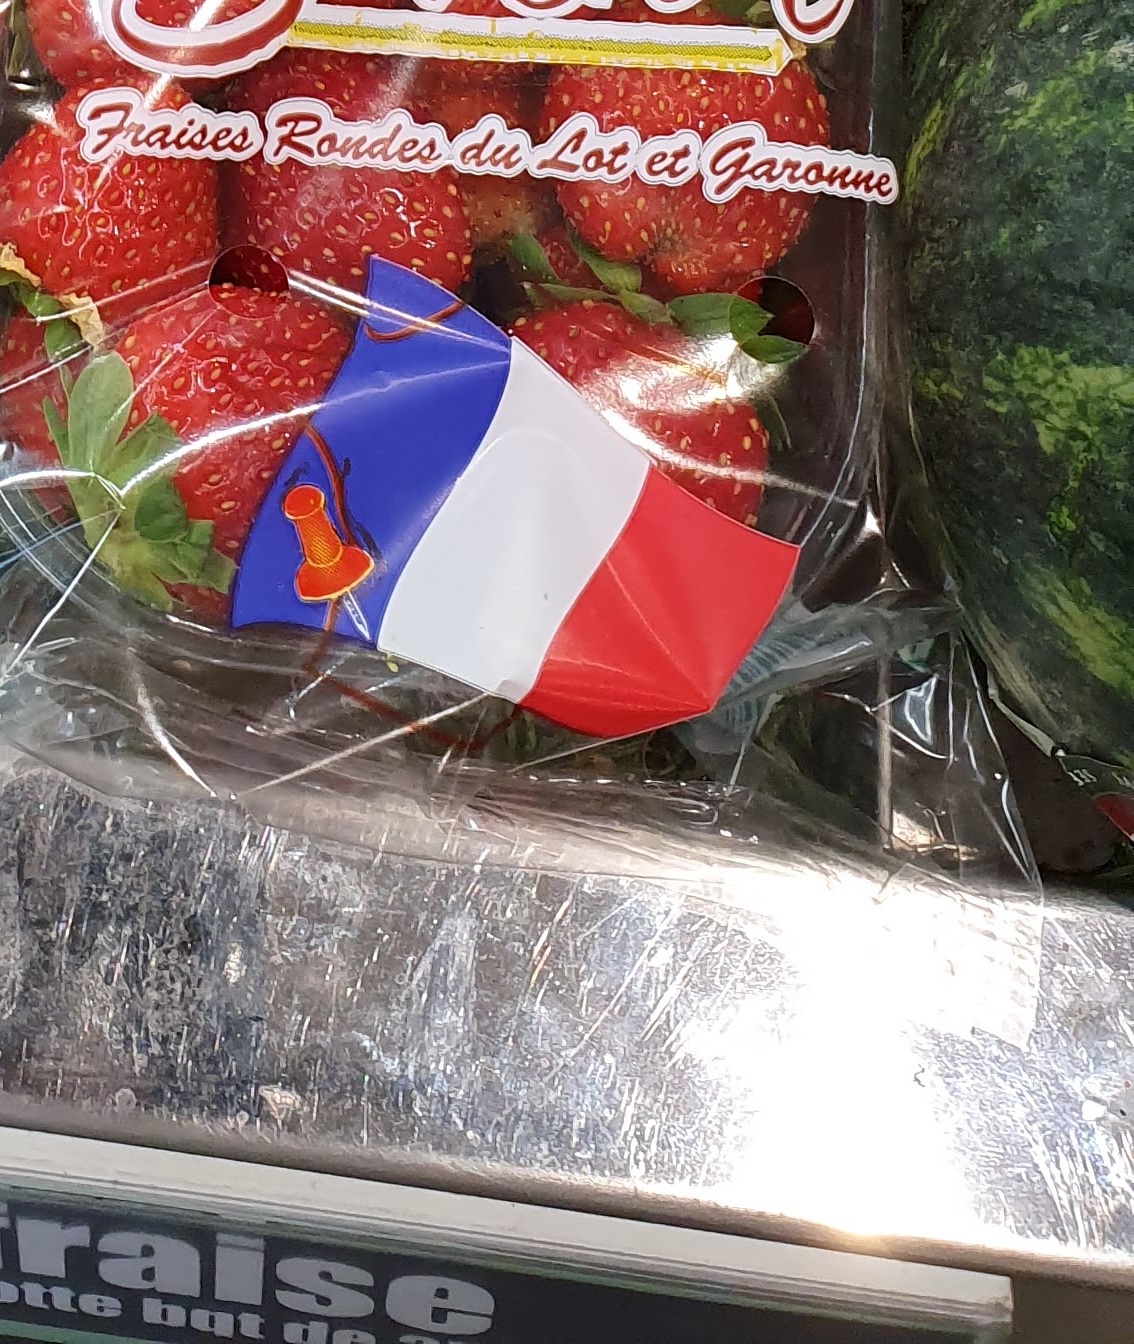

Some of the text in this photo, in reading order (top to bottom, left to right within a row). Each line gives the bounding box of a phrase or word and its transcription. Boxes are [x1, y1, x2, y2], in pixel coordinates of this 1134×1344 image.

[86, 101, 895, 198] Fraises Rondes du Lot et Garonne
